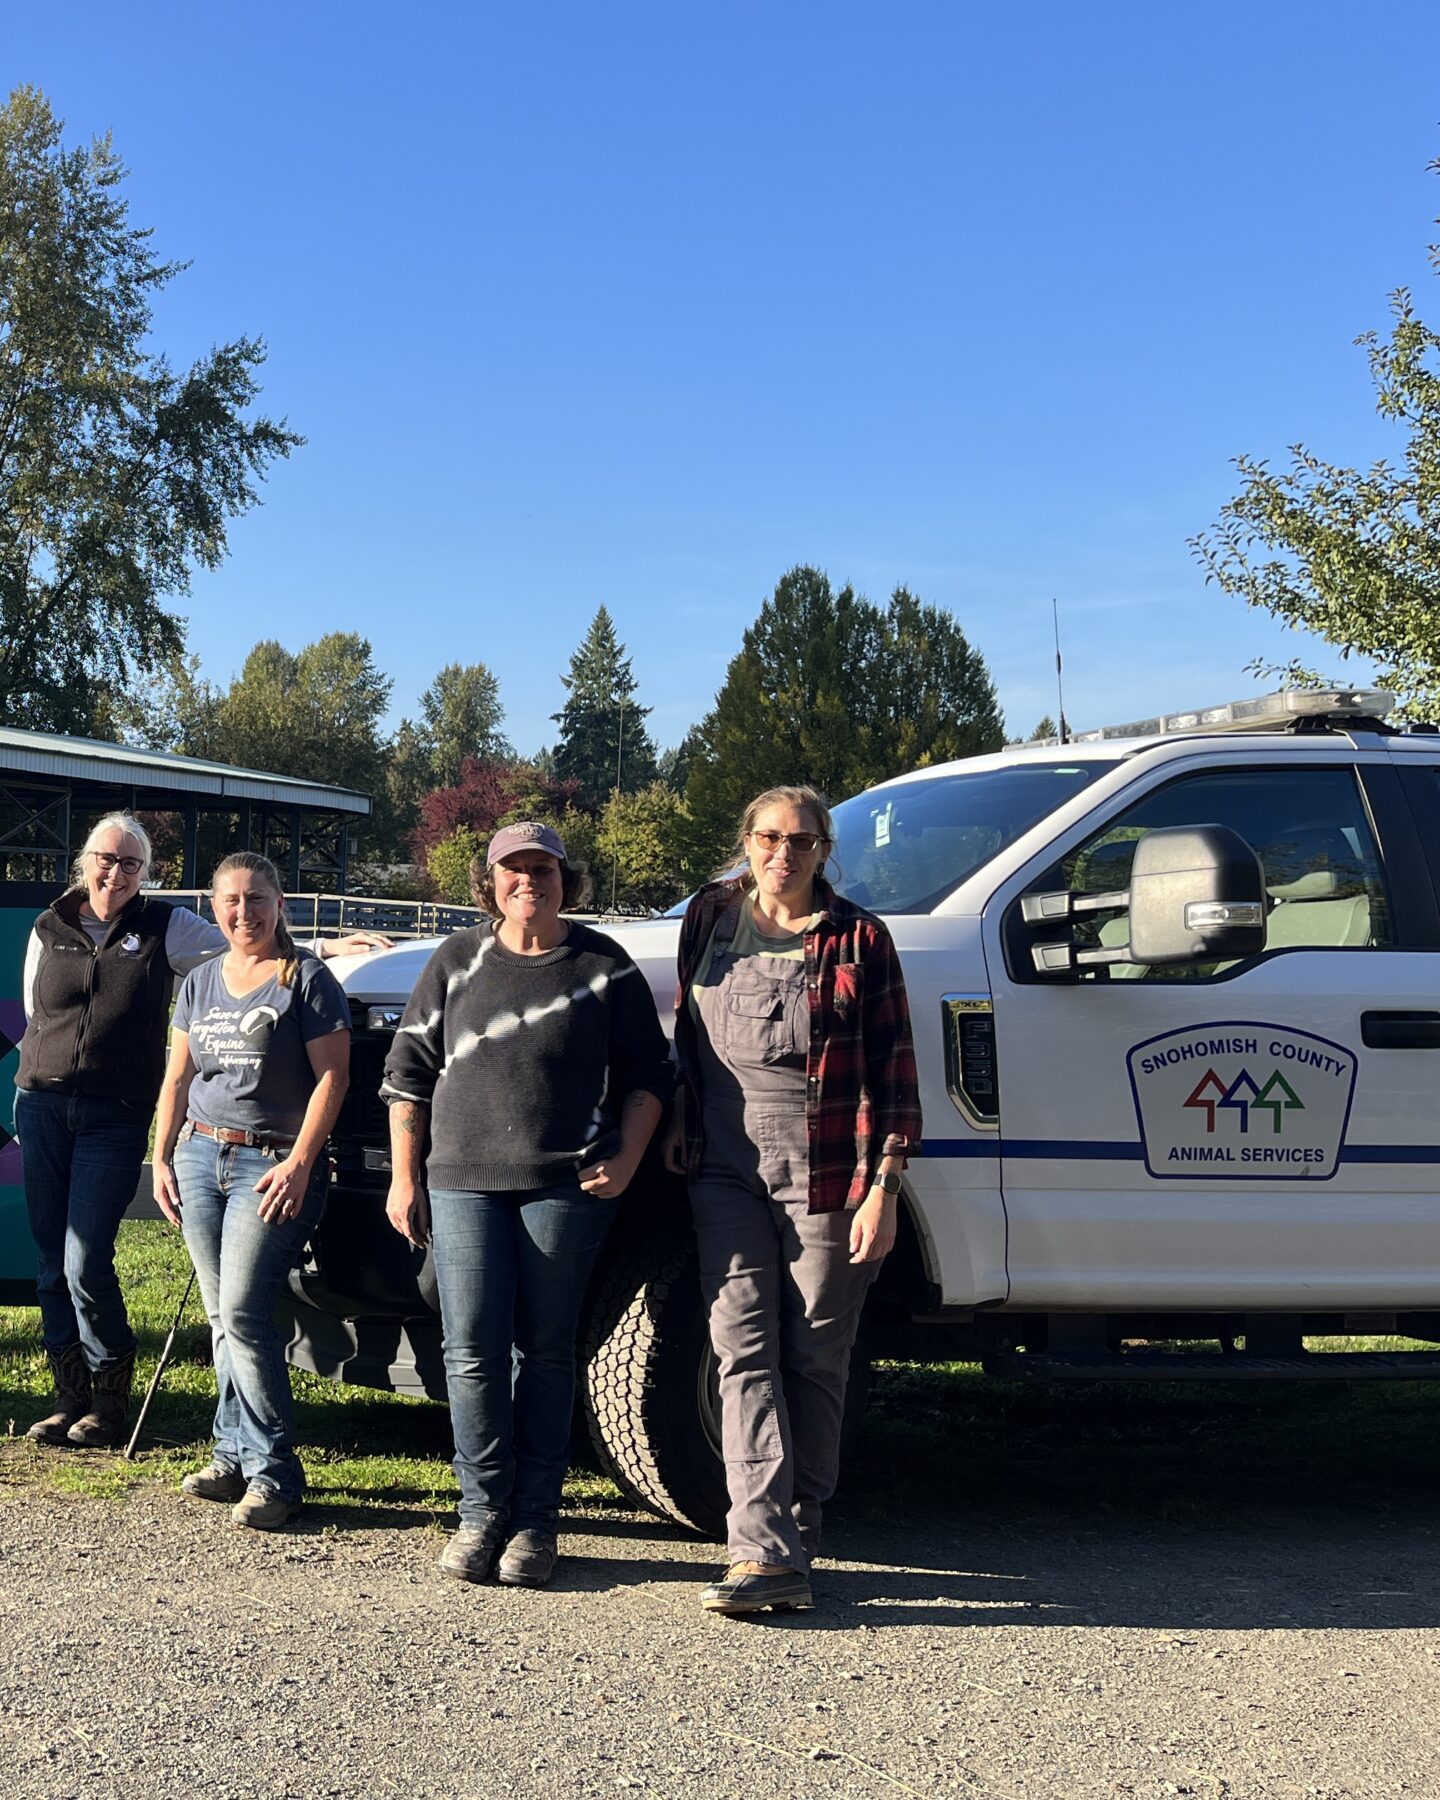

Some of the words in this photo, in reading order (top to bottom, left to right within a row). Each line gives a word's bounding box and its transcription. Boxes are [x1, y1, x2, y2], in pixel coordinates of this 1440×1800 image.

[189, 1020, 237, 1042] Forgotten
[204, 1035, 246, 1056] Equine
[1140, 1038, 1258, 1074] SNOHOMISH
[1268, 1041, 1347, 1077] COUNTY
[1167, 1147, 1236, 1162] ANIMAL
[1240, 1148, 1325, 1162] SERVICES
